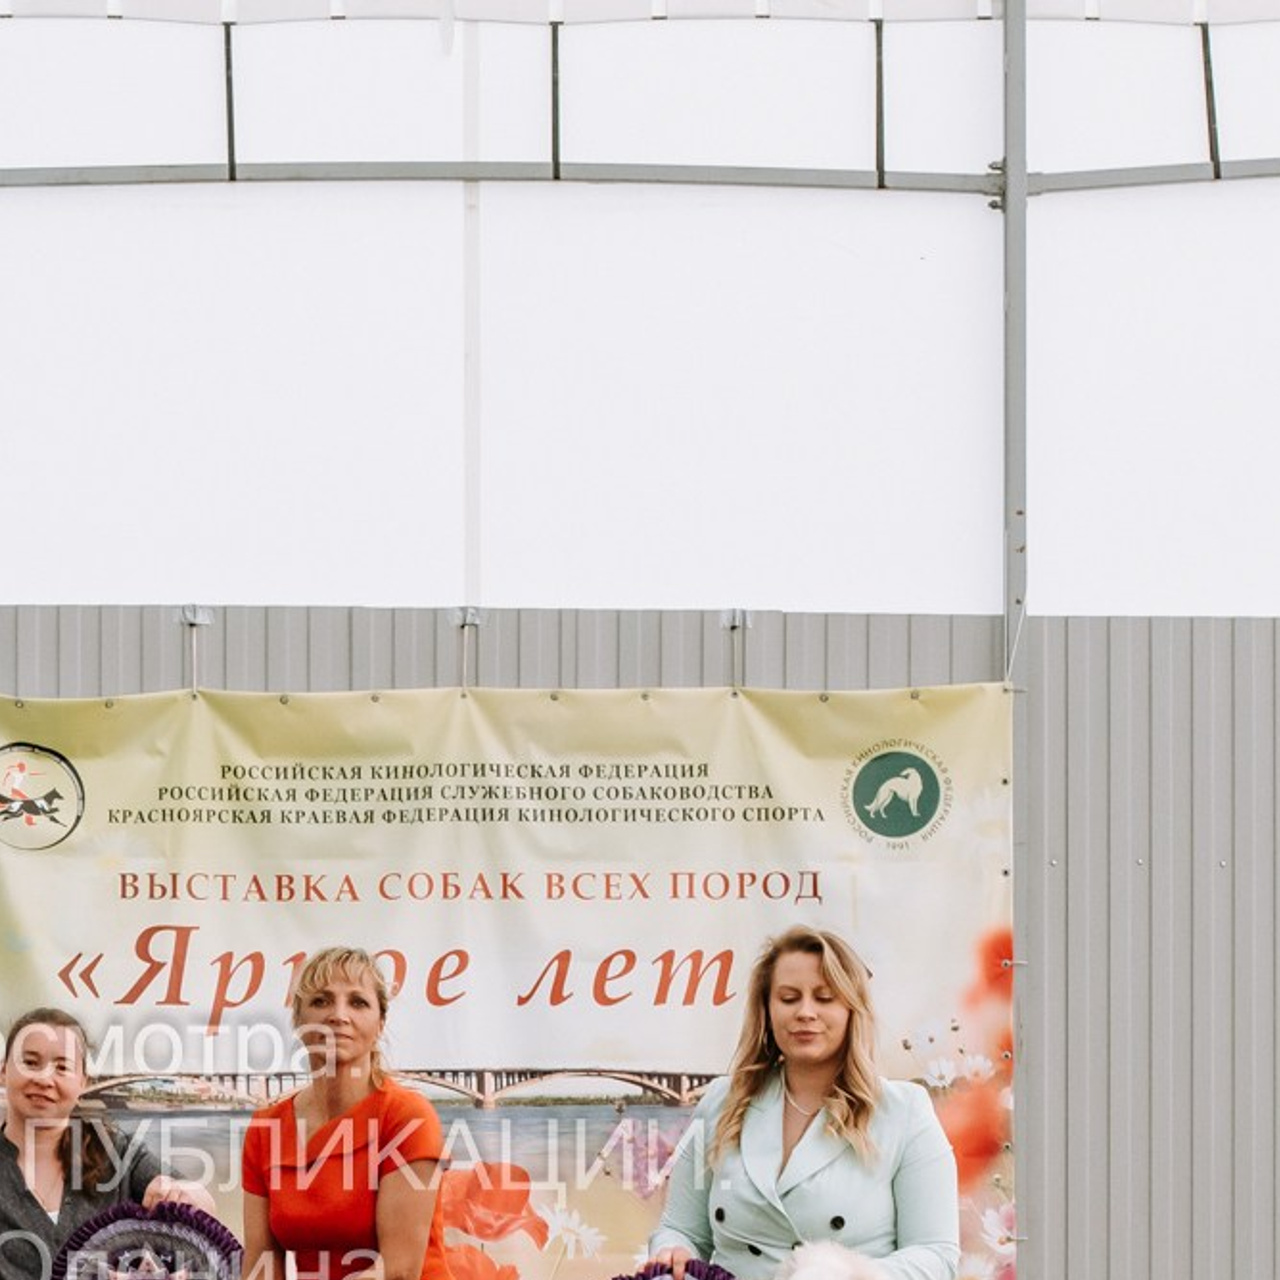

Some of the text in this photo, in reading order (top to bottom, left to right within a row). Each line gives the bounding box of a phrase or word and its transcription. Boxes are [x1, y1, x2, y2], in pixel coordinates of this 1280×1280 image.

[220, 762, 709, 781] РОССИЙСКАЯ КИНОЛОГИЧЕСКАЯ ФЕДЕРАЦИЯ
[158, 784, 774, 803] РОССИЙСКАЯ ФЕДЕРАЦИЯ СЛУЖЕБНОГО СОБАКОВОДСТВА
[107, 806, 826, 825] КРАСНОЯРСКАЯ КРАЕВАЯ ФЕДЕРАЦИЯ КИНОЛОГИЧЕСКОГО СПОРТА
[118, 870, 824, 906] ВЫСТАВКА СОБАК ВСЕХ ПОРОД
[517, 947, 737, 1007] лет
